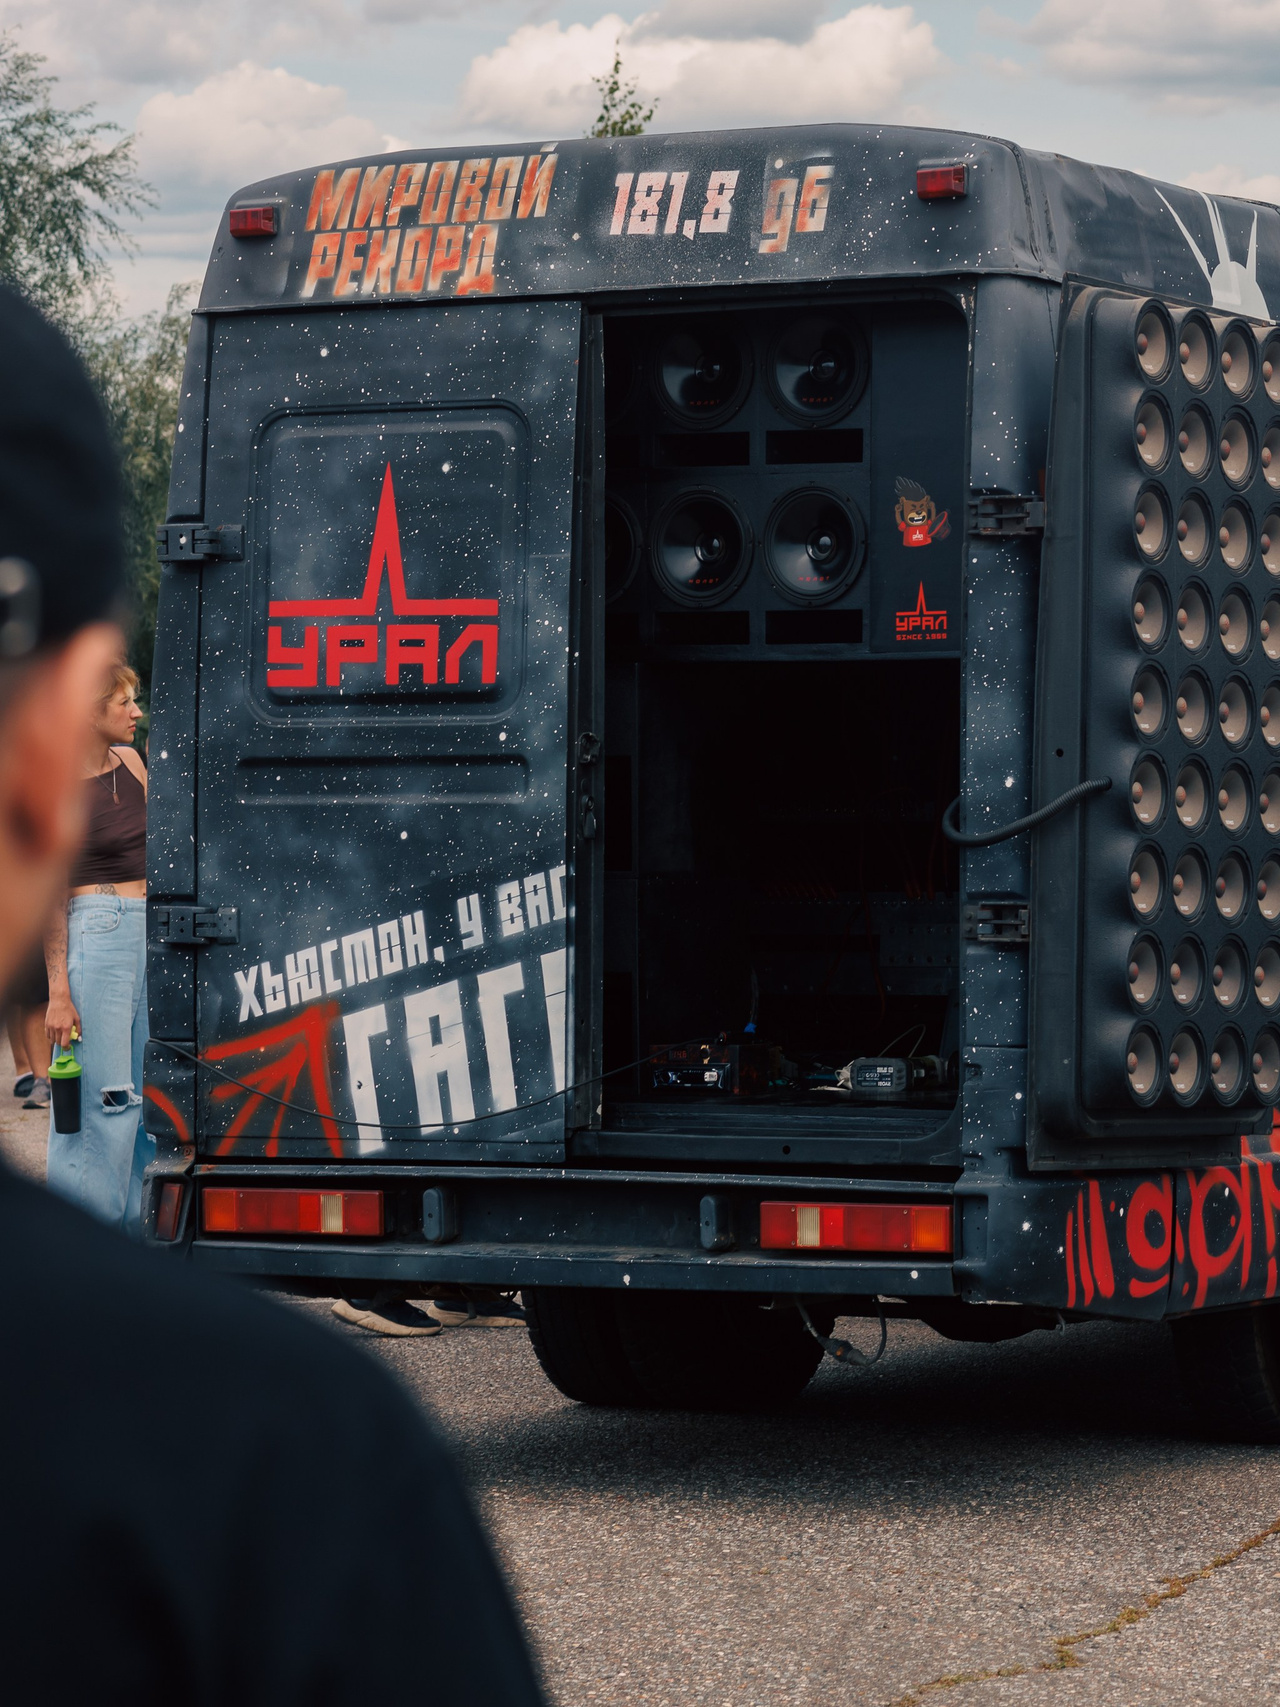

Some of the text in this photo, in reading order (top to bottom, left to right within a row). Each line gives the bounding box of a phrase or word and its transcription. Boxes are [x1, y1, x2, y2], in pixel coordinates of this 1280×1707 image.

[304, 141, 559, 231] МИРОВОЙ
[609, 170, 740, 240] 181,8
[301, 224, 499, 298] РЕКОРД
[267, 623, 499, 688] УРАЛ
[895, 616, 948, 631] УРАЛ
[895, 633, 923, 641] SINCE
[233, 910, 445, 1023] ХЬЮСТОН,
[456, 892, 485, 951] У
